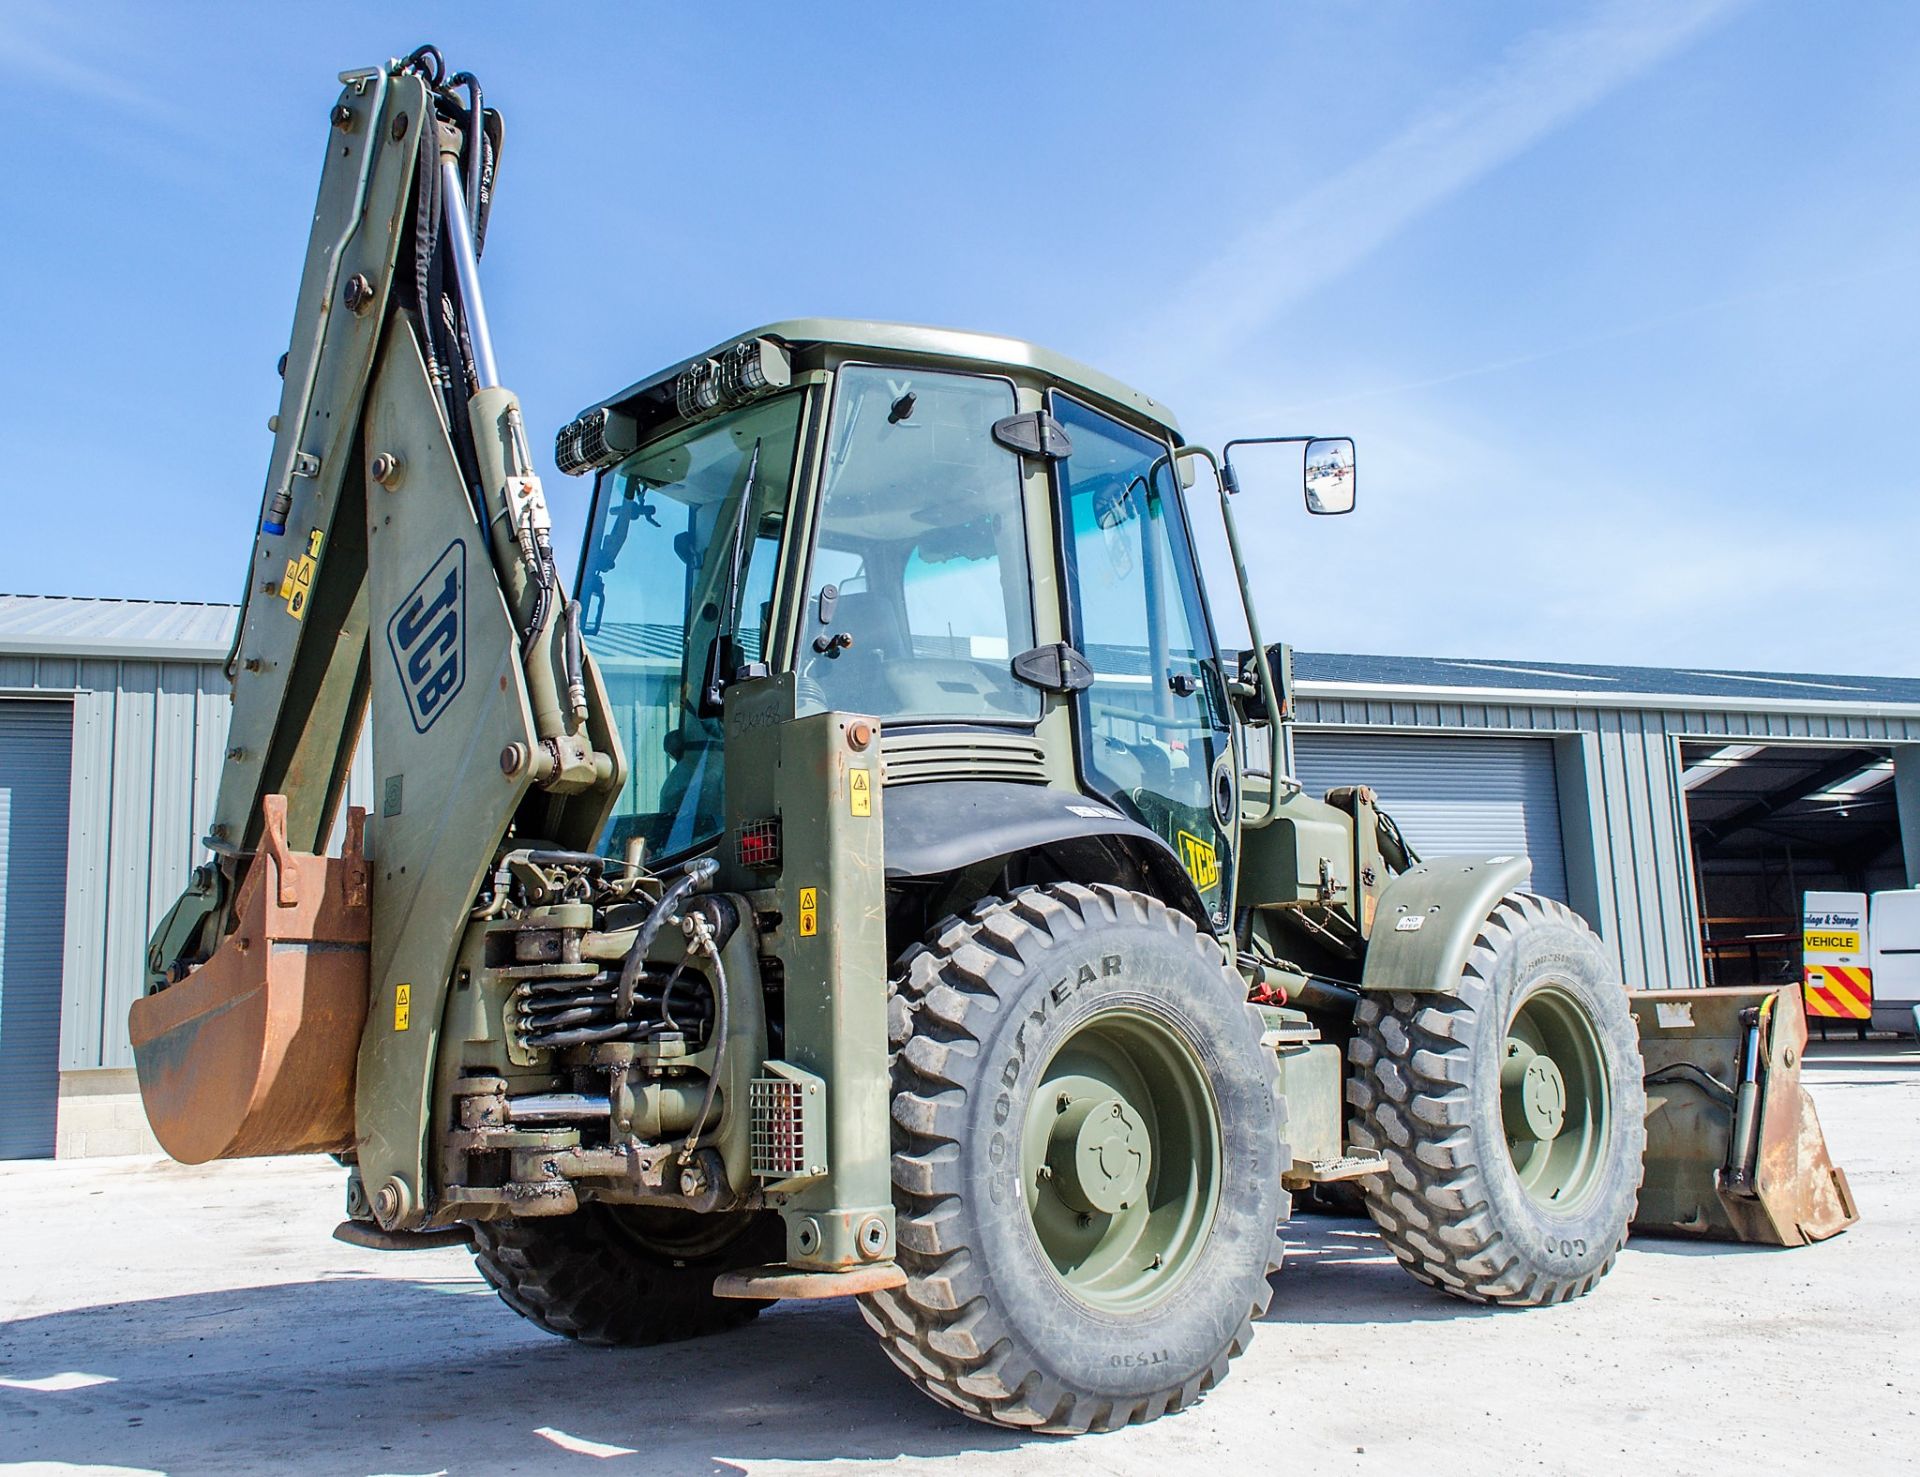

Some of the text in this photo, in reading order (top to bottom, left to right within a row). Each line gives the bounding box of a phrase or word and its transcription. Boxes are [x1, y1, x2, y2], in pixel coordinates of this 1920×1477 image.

[397, 566, 458, 716] JCB
[1185, 838, 1217, 887] JCB
[1824, 914, 1830, 925] &
[1832, 914, 1859, 927] Storage
[1806, 936, 1853, 948] VEHICLE
[1110, 1349, 1169, 1368] IT530
